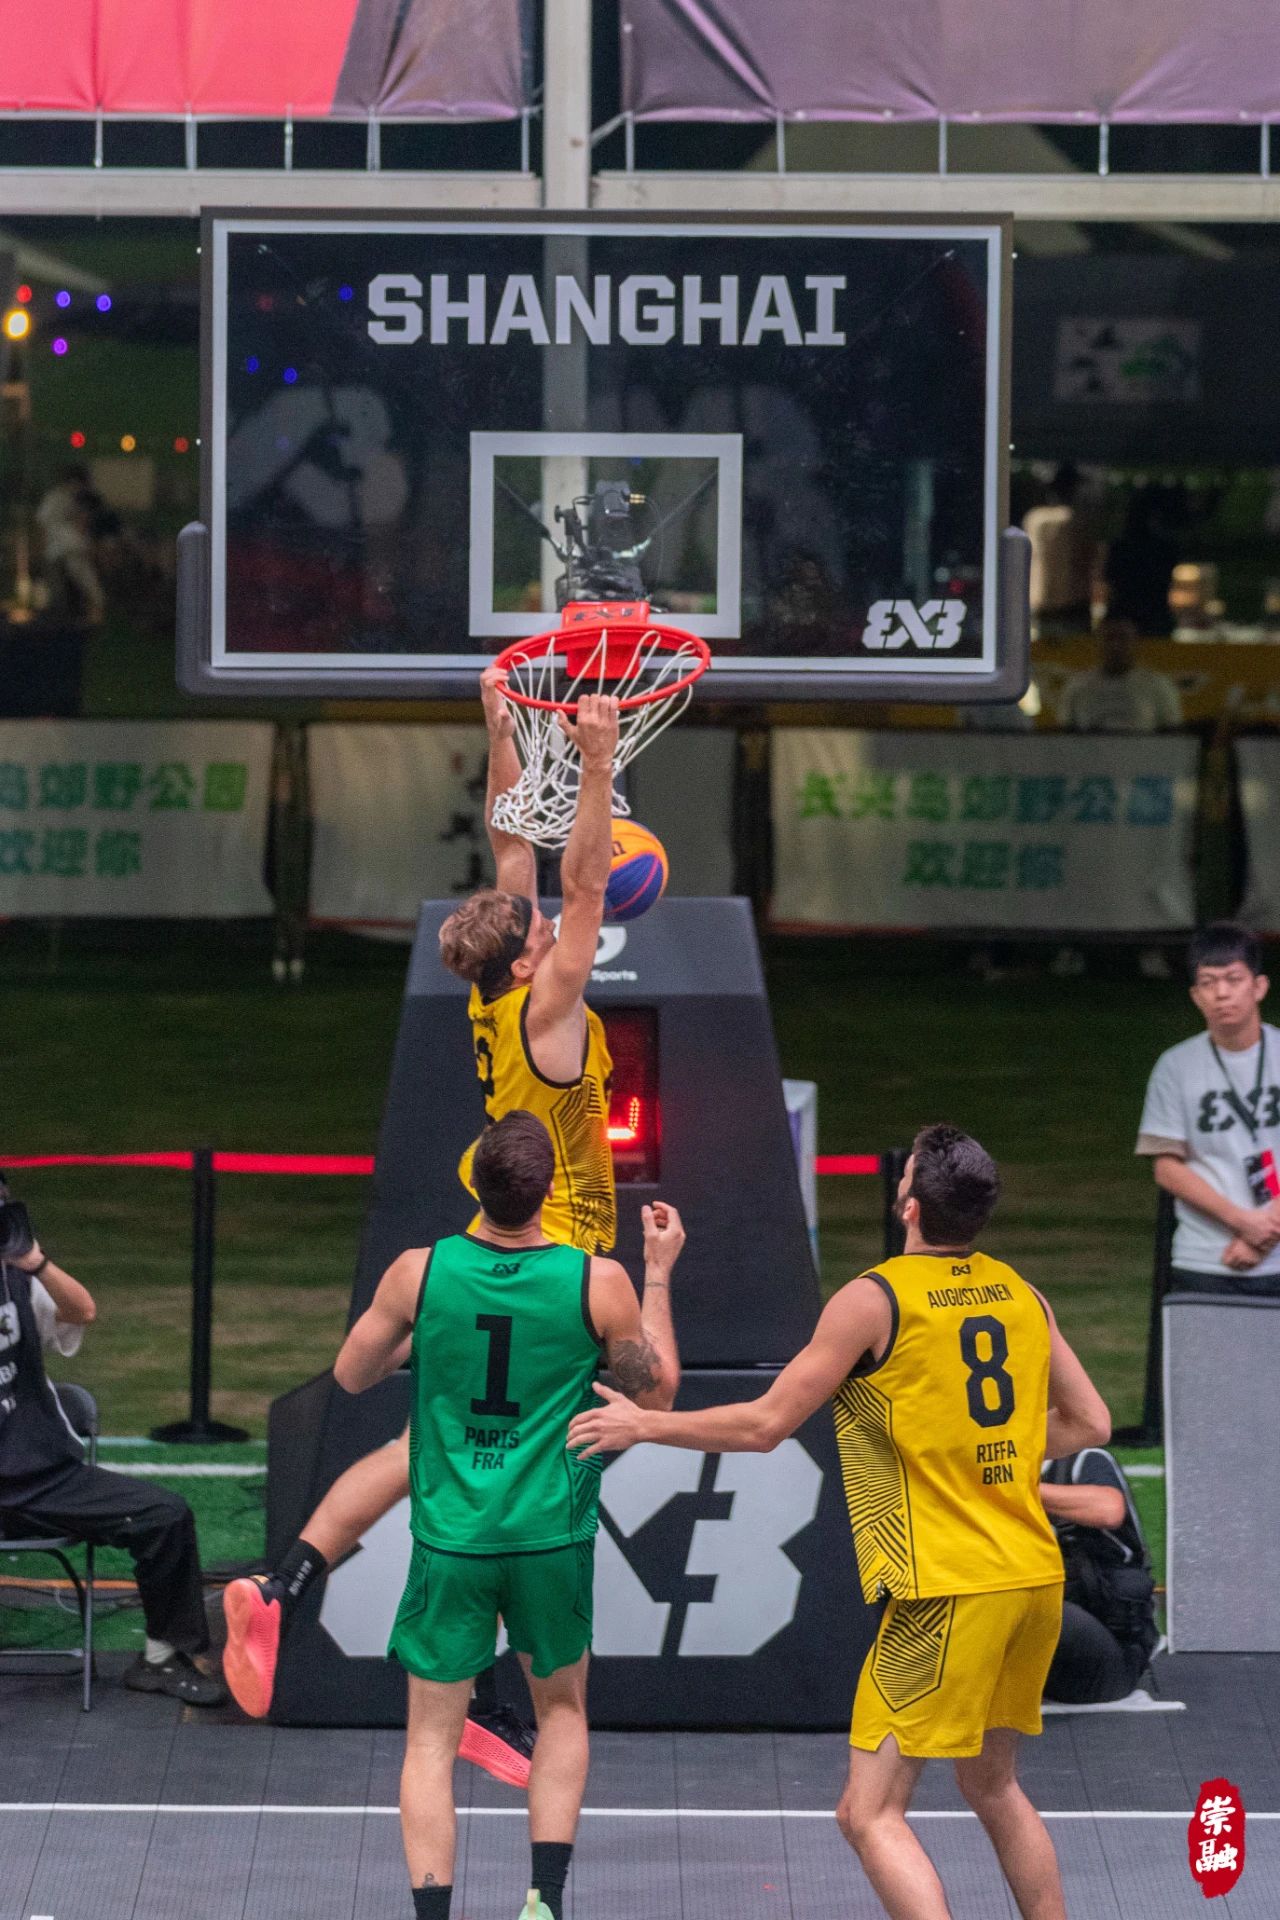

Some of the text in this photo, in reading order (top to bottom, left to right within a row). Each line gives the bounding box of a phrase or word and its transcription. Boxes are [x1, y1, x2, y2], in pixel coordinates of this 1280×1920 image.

[367, 274, 846, 345] SHANGHAI
[927, 1283, 1014, 1309] AUGUSTIJNEN
[470, 1313, 520, 1418] 1
[959, 1315, 1015, 1428] 8
[464, 1425, 520, 1449] PARIS
[472, 1450, 505, 1470] FRA
[976, 1439, 1018, 1464] RIFFA
[982, 1463, 1014, 1485] BRN
